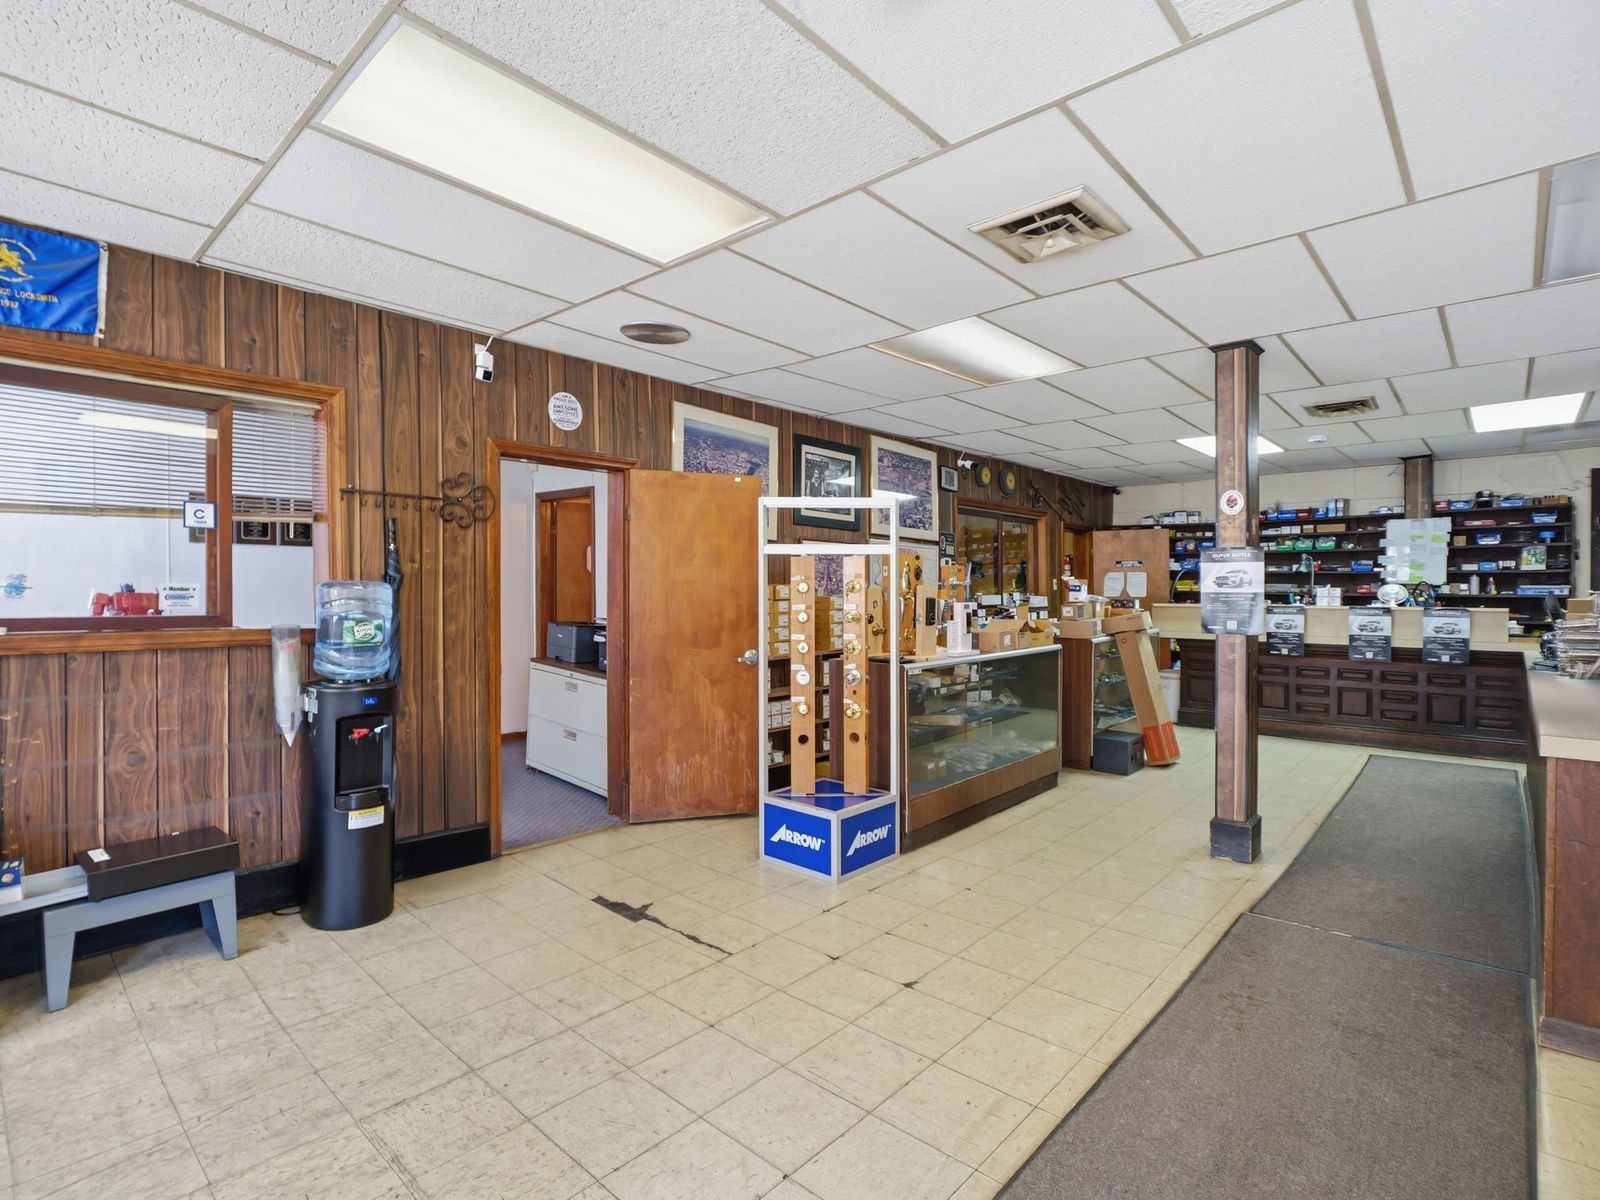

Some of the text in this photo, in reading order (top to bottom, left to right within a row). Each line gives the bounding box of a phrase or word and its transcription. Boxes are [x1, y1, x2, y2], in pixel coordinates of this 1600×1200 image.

[14, 289, 59, 303] LOCKSMITH
[194, 509, 205, 519] C
[770, 823, 822, 852] ARROW
[846, 825, 889, 857] ARROW
